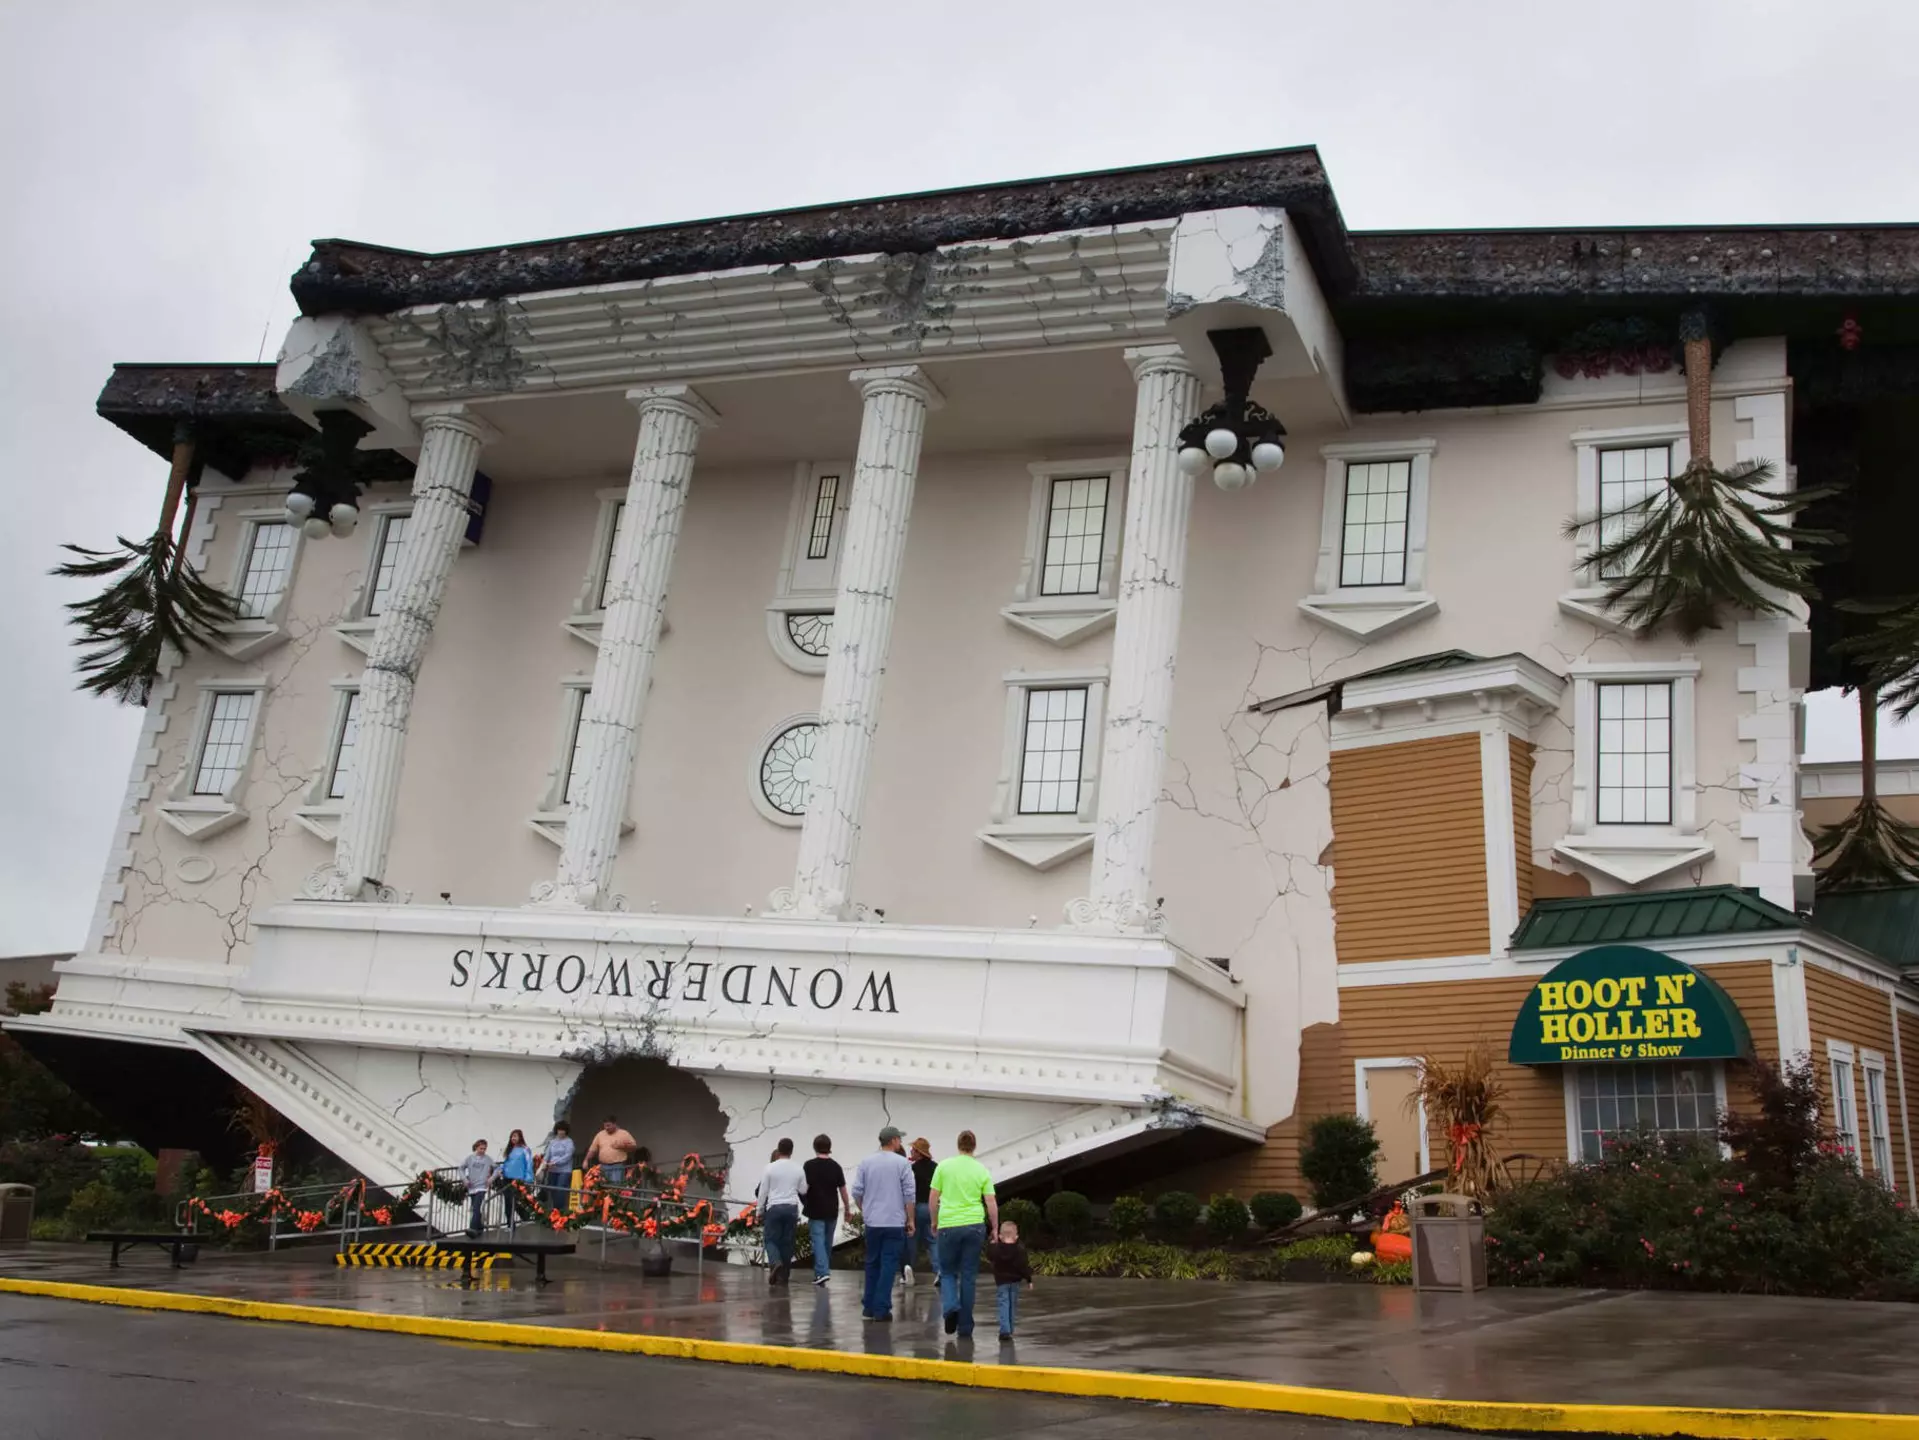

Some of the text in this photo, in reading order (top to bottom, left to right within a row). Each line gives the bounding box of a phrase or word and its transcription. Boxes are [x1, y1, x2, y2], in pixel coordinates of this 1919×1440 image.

[450, 949, 899, 1013] WONDERWORKS
[1538, 973, 1696, 1011] HOOT N'
[1540, 1008, 1702, 1043] HOLLER
[1561, 1043, 1683, 1060] Dinner & Show
